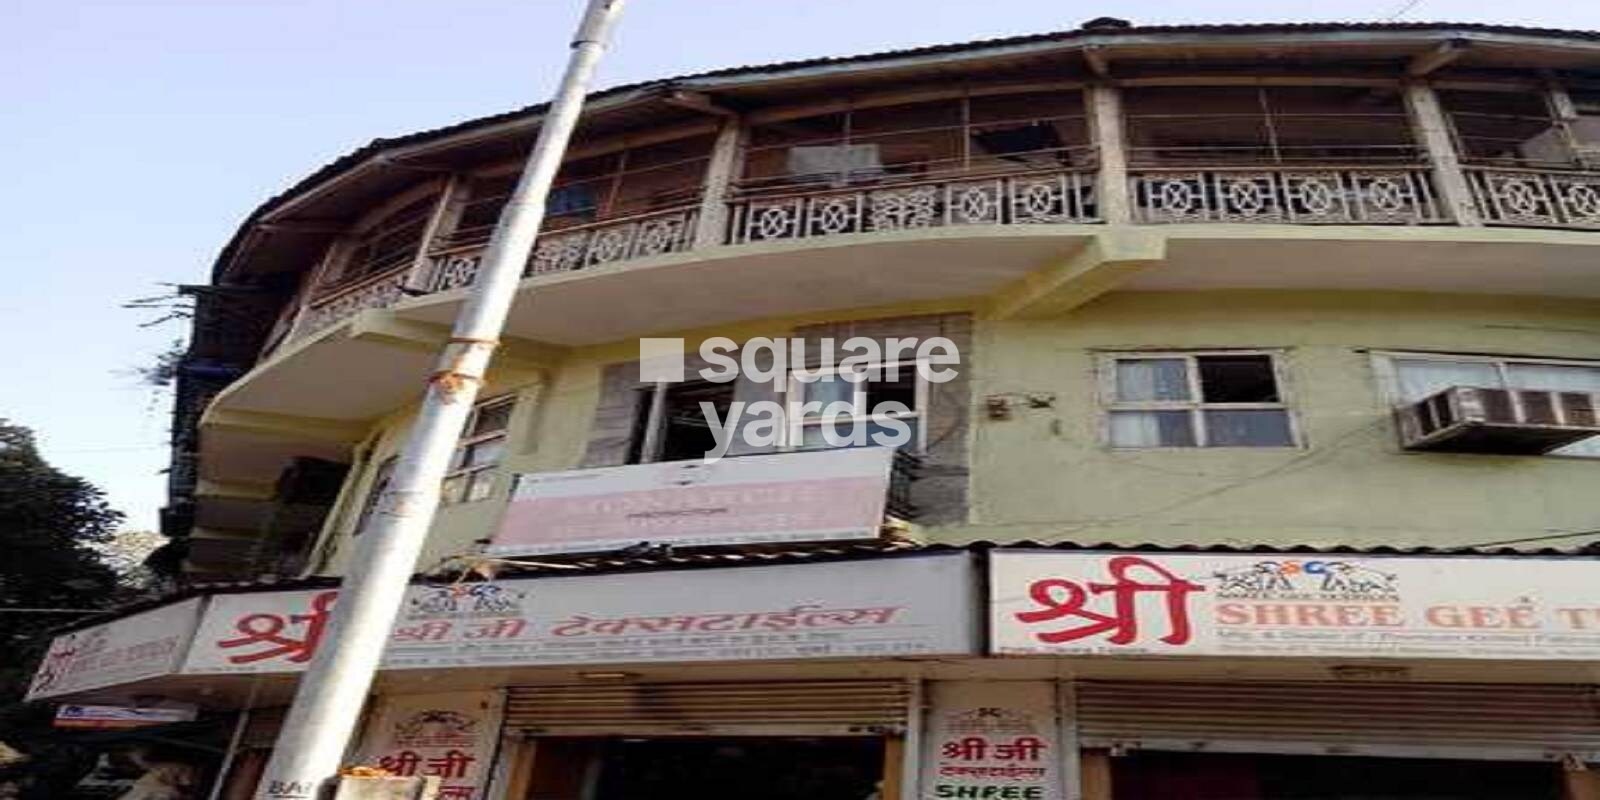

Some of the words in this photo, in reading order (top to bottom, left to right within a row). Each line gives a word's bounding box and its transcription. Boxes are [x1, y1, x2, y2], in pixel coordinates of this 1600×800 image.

[1015, 556, 1205, 645] श्री
[392, 619, 452, 642] श्री
[463, 617, 529, 639] जी
[1215, 603, 1402, 627] SHREE
[1426, 605, 1540, 629] GEE
[1552, 607, 1600, 630] T
[942, 736, 988, 761] श्री
[992, 736, 1047, 761] जी
